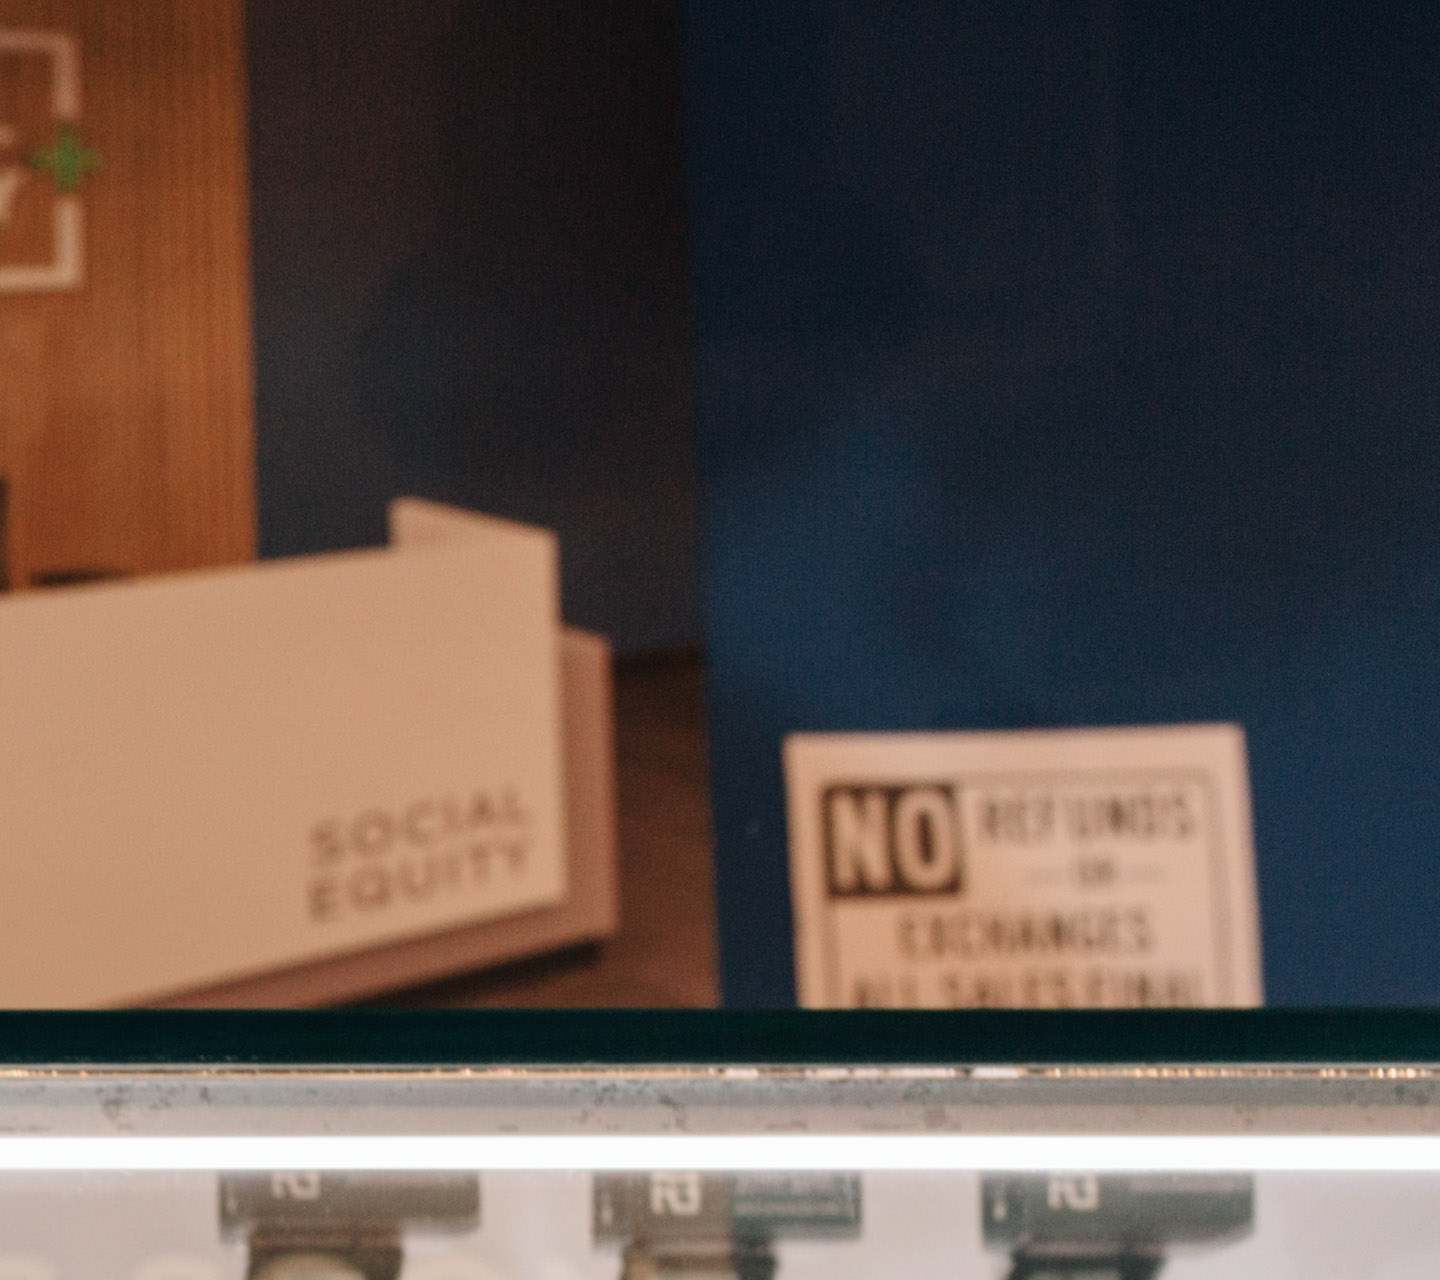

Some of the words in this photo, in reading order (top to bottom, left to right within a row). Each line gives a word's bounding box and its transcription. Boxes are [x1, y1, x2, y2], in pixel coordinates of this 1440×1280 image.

[308, 783, 524, 865] SOCIAL
[830, 789, 958, 894] NO
[307, 841, 528, 922] EQUITY
